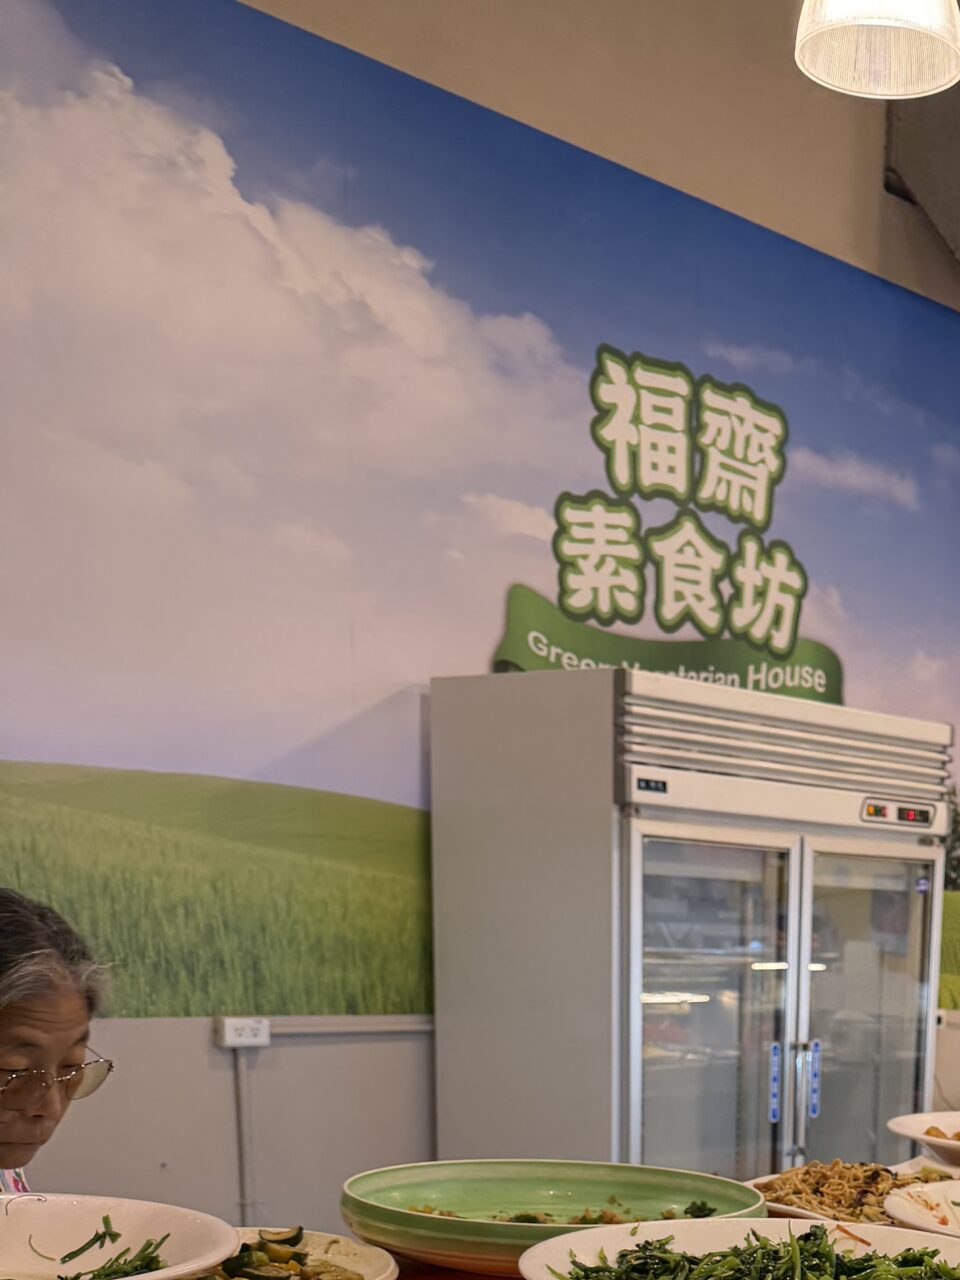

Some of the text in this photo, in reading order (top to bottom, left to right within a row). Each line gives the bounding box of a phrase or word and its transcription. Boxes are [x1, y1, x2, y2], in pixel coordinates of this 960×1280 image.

[594, 349, 785, 527] 福齋
[557, 495, 804, 656] 素食坊
[747, 662, 826, 693] House
